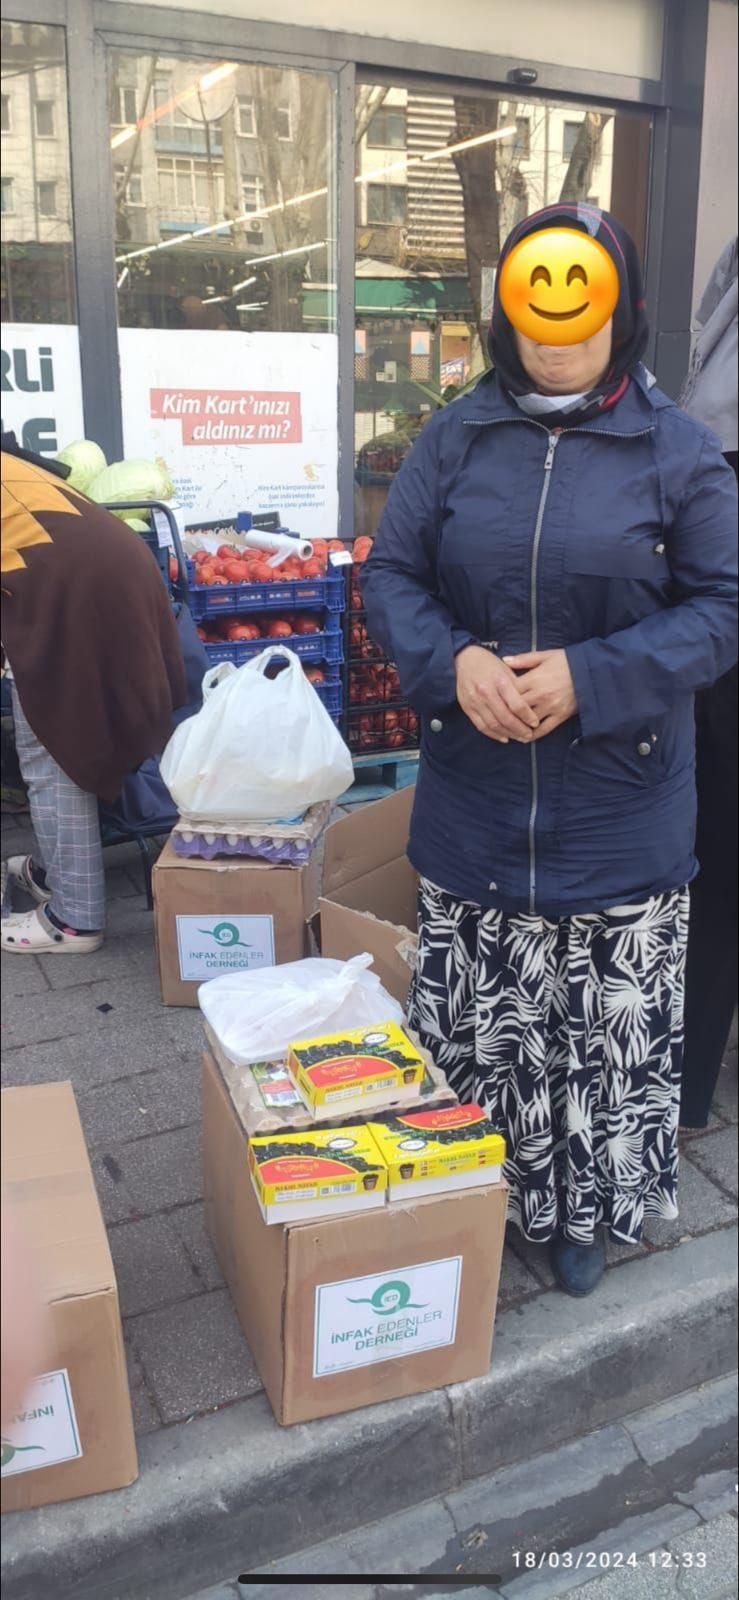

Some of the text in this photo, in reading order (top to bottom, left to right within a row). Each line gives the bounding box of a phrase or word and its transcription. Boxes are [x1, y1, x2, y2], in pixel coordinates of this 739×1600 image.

[162, 393, 290, 415] Kim Kart'ınızı
[192, 419, 290, 441] aldınız mı?
[189, 950, 264, 960] İNFAK EDENLER
[206, 959, 249, 968] DERNEĞİ
[331, 1310, 442, 1345] İNFAK EDENLER
[354, 1326, 418, 1351] DERNEĞİ
